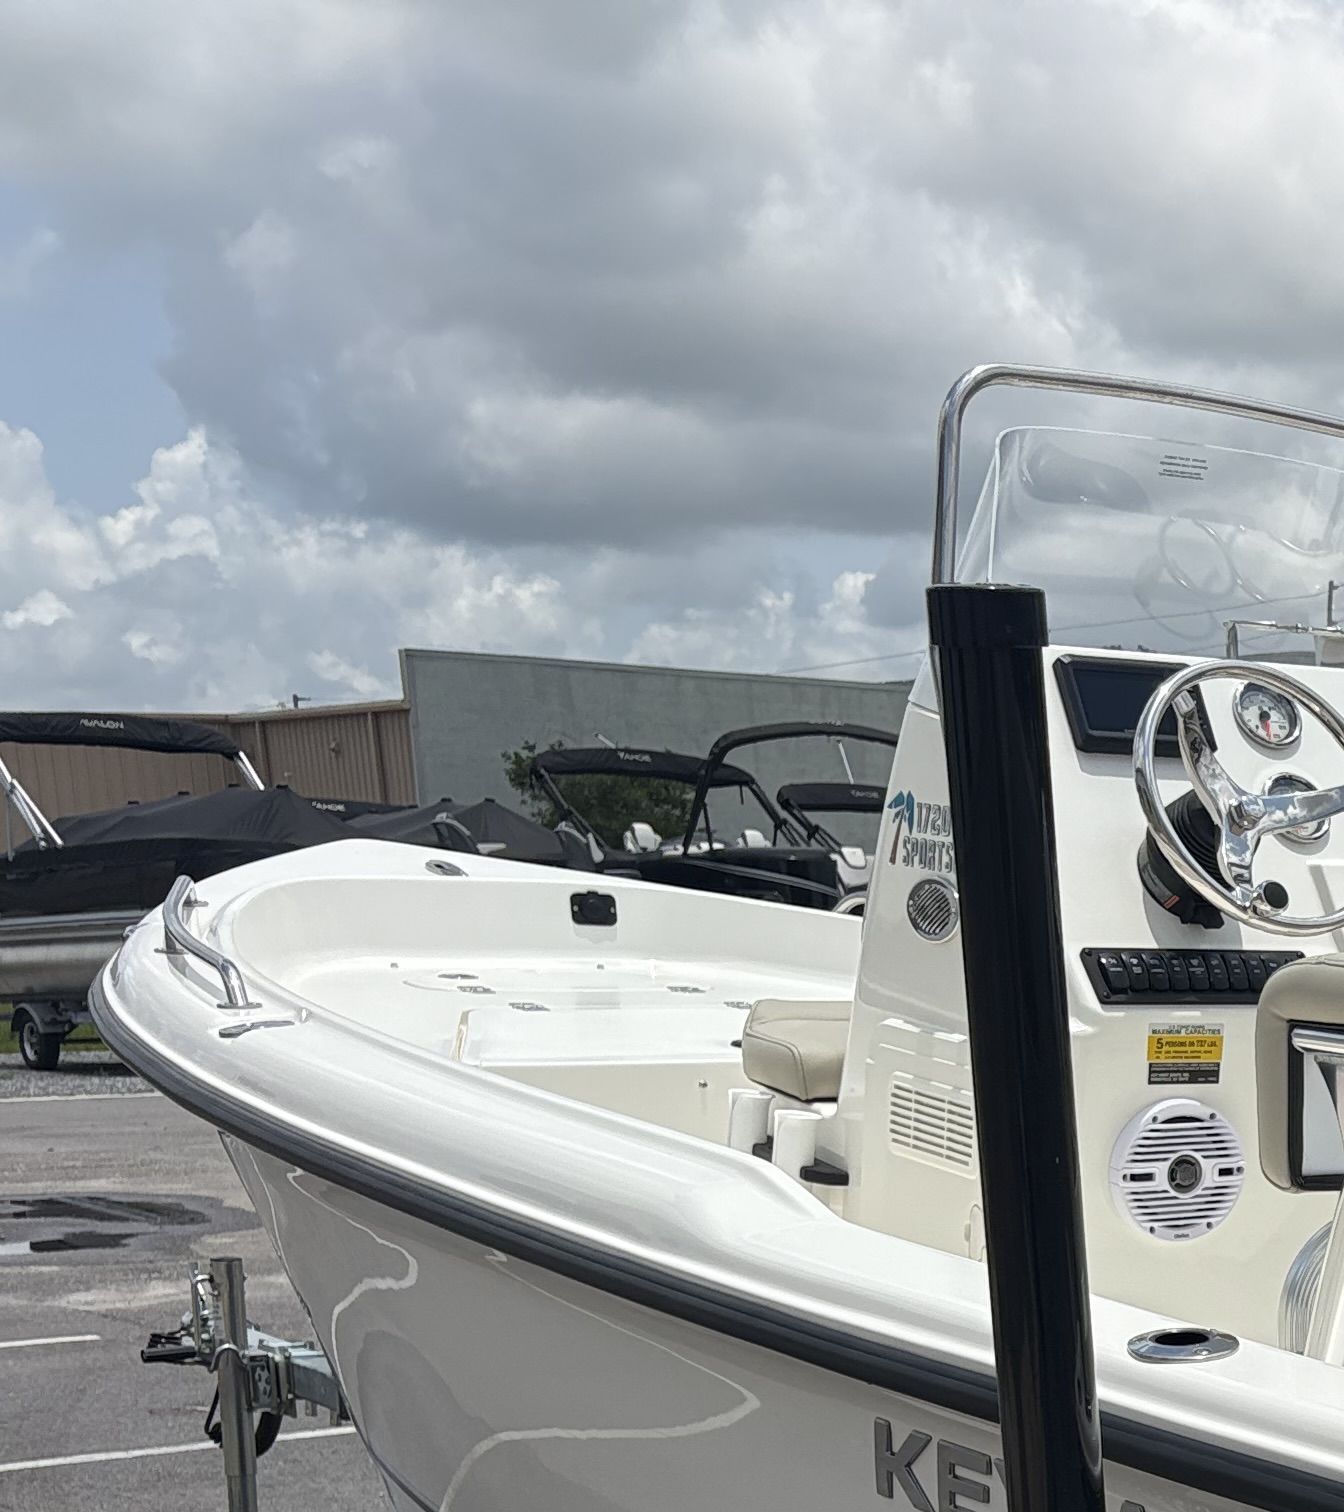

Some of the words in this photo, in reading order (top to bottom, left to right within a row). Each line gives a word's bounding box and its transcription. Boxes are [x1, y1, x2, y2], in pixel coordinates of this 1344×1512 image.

[916, 802, 951, 837] 1720
[901, 835, 954, 873] SPORTS
[1155, 1037, 1164, 1050] 5
